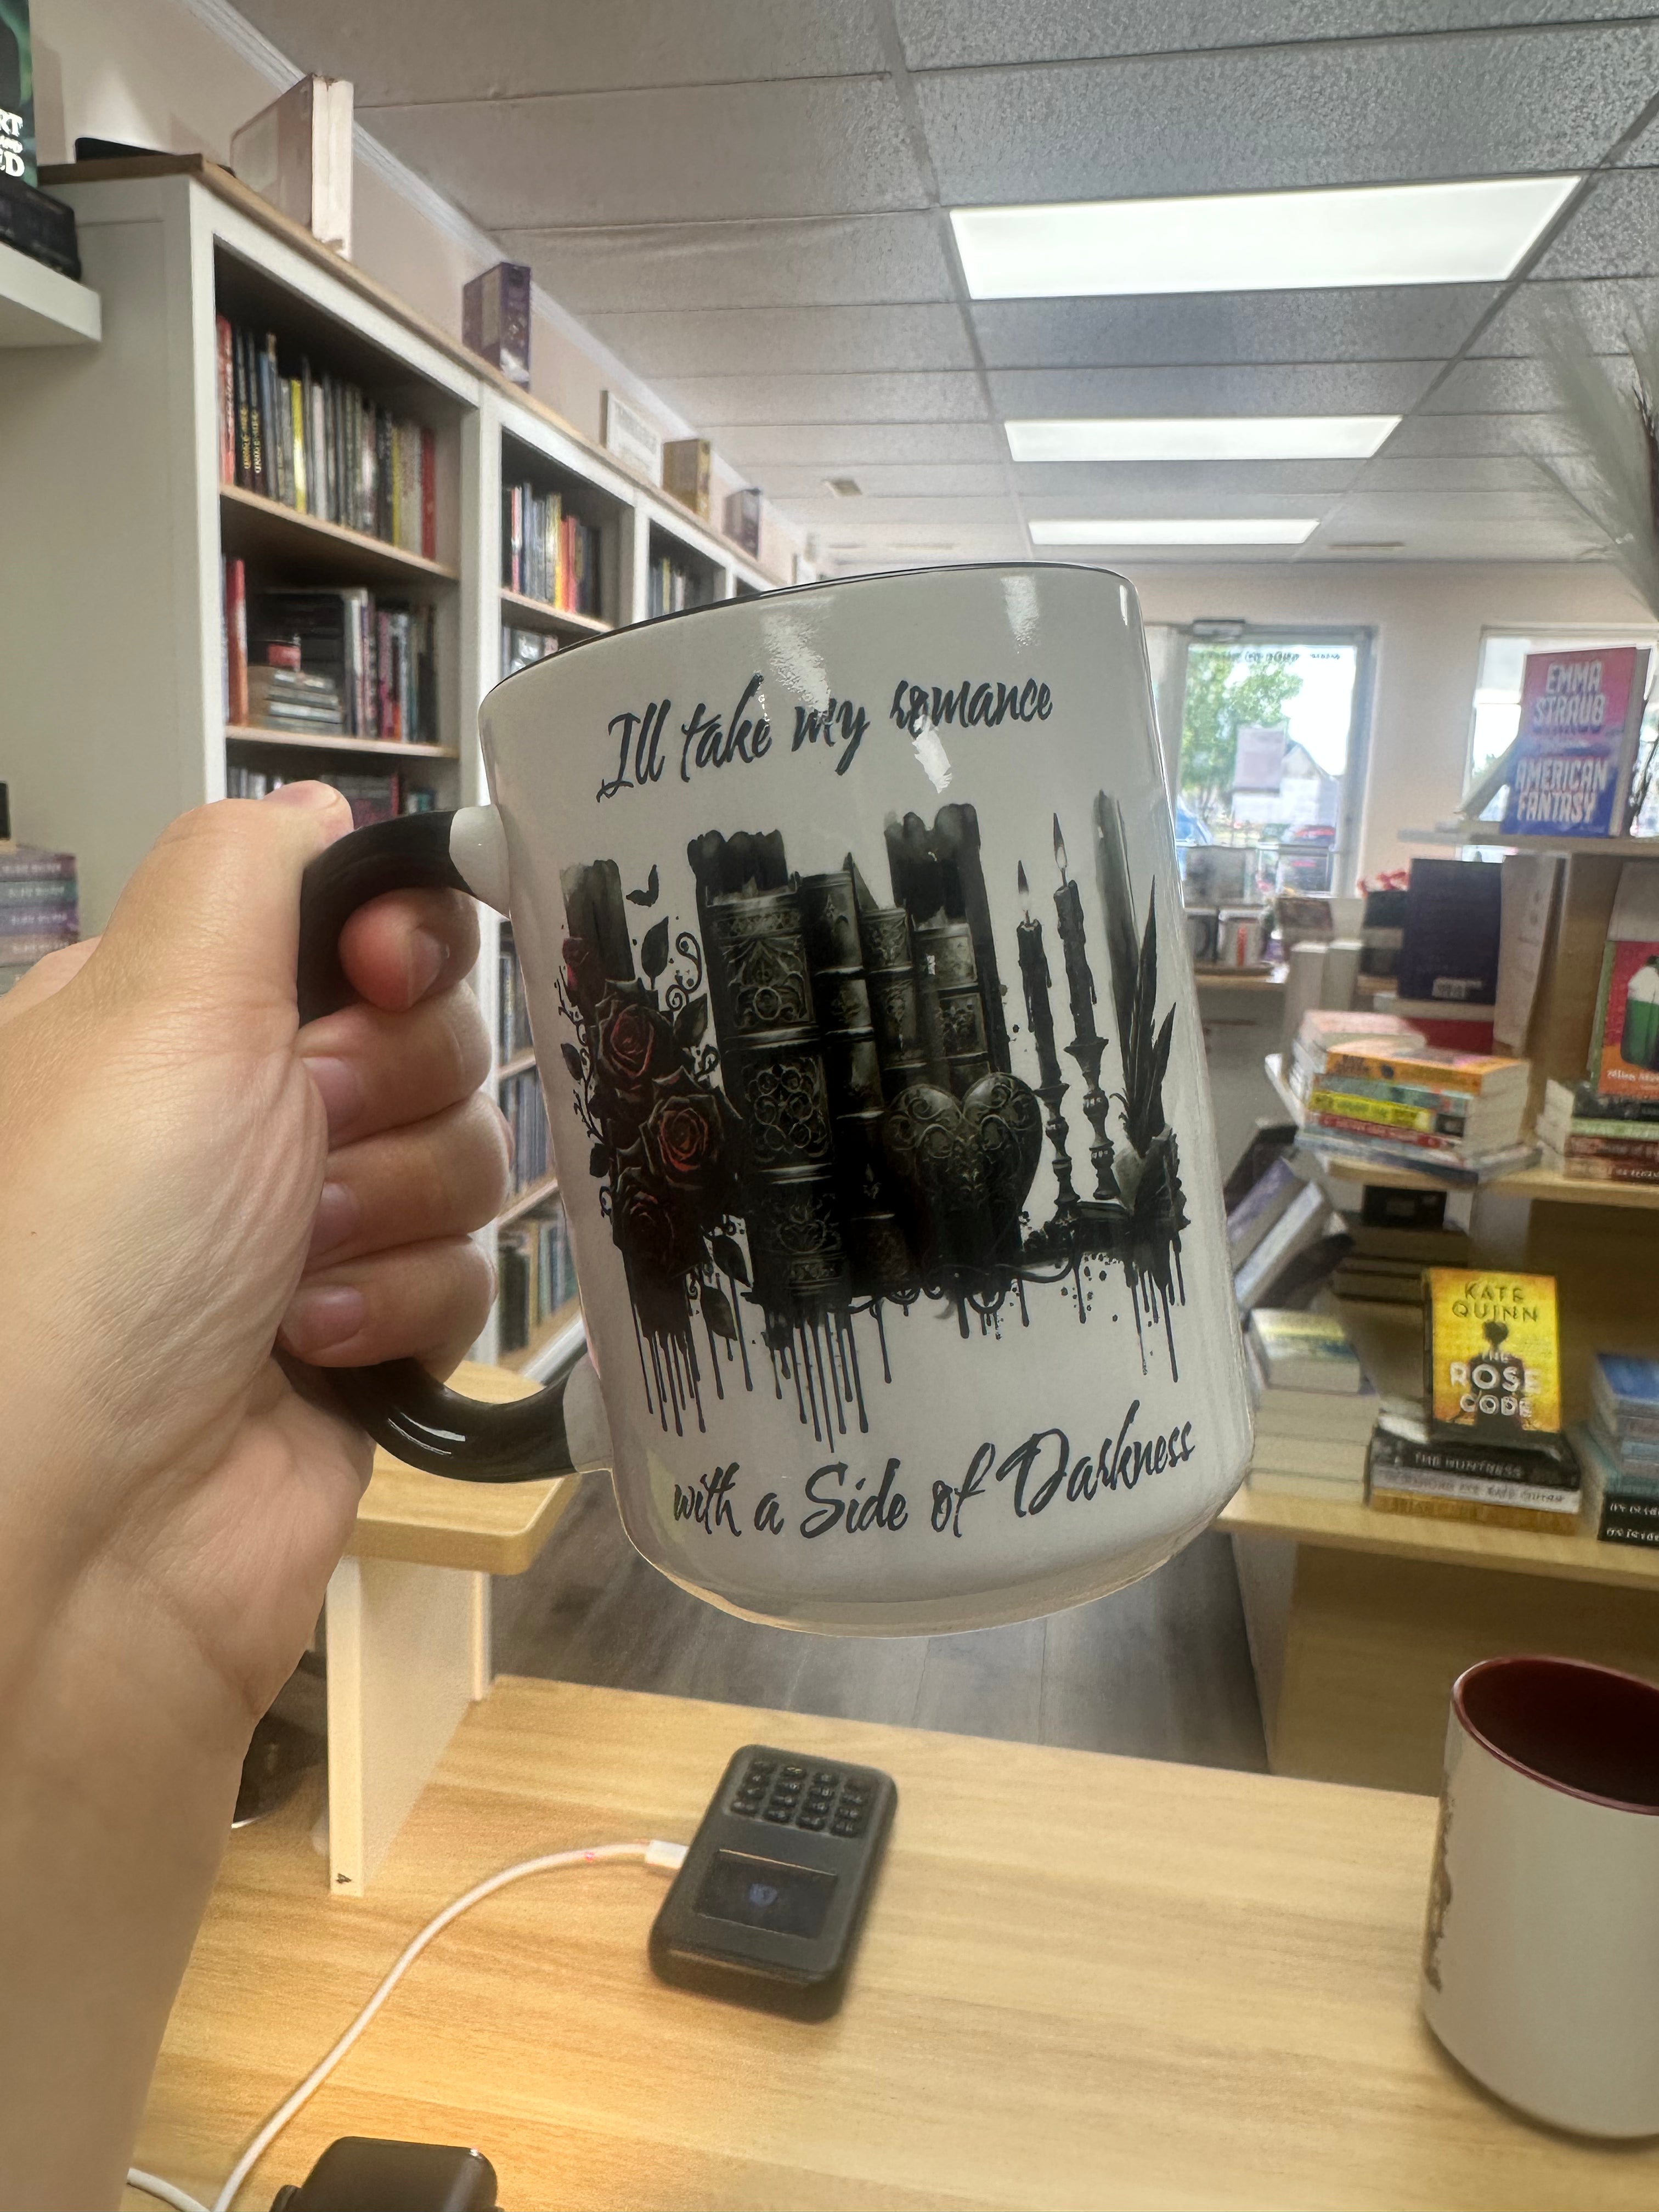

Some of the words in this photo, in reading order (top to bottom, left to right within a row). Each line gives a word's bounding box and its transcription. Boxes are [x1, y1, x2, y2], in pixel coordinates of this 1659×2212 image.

[1545, 659, 1602, 695] EMMA
[681, 673, 772, 783] take
[792, 697, 871, 776] my
[889, 678, 1053, 740] romance
[1534, 693, 1606, 729] STRAUB
[1515, 756, 1608, 792] AMERICAN
[1516, 791, 1598, 823] FANTASY
[1465, 1280, 1525, 1302] KATE
[1452, 1299, 1538, 1322] QUINN
[1449, 1362, 1542, 1395] ROSE
[1459, 1393, 1533, 1418] CODE
[673, 1461, 742, 1537] with
[753, 1492, 785, 1536] a
[799, 1457, 910, 1539] Side
[930, 1442, 996, 1538] of
[996, 1399, 1196, 1518] Darkness
